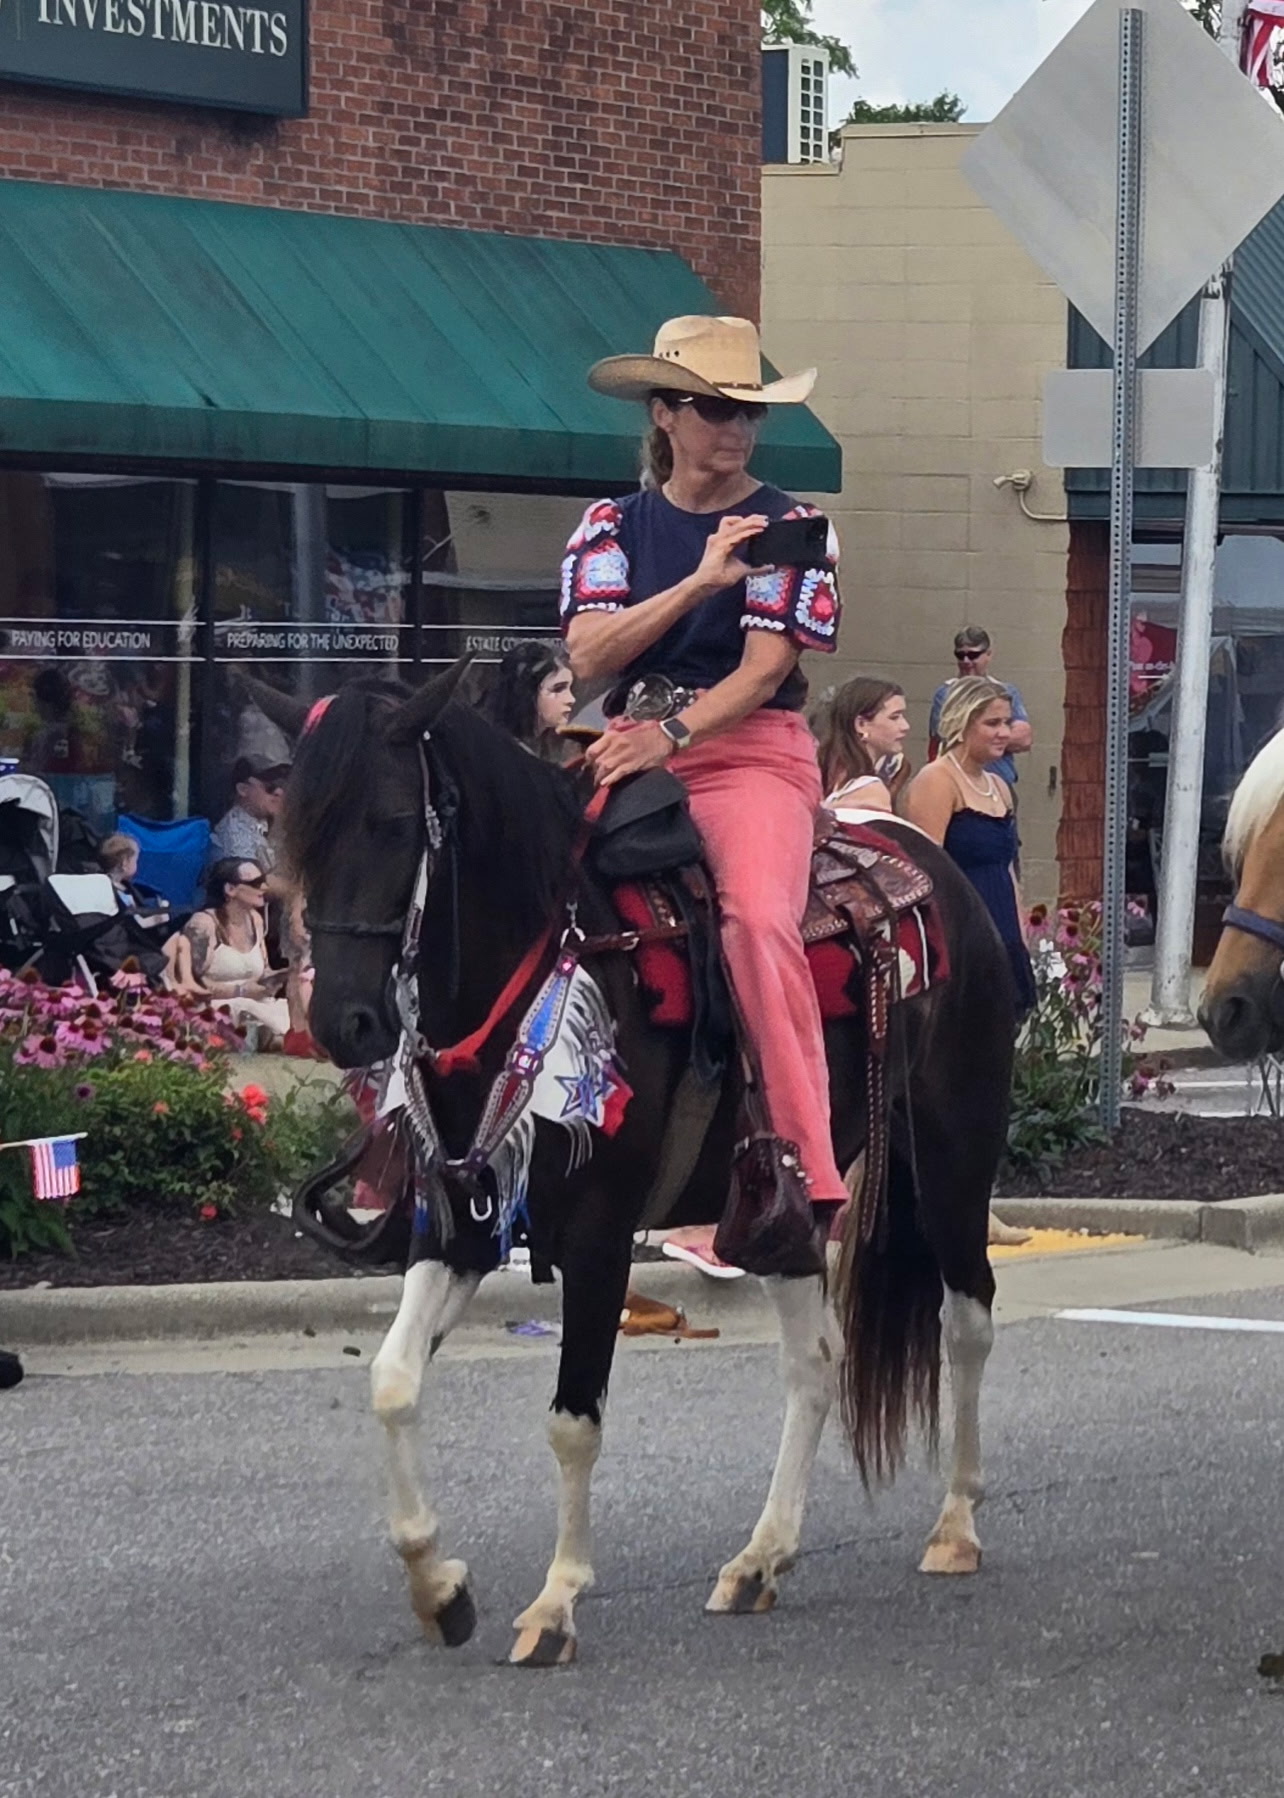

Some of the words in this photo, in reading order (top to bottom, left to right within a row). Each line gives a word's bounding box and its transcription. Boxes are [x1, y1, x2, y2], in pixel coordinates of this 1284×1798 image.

[38, 0, 288, 57] INVESTMENTS
[11, 630, 56, 648] PAYING
[57, 631, 81, 648] FOR
[83, 632, 151, 648] EDUCATION
[227, 632, 286, 649] PREPARING
[288, 633, 309, 649] FOR
[311, 634, 331, 650] THE
[333, 635, 399, 650] UNEXPECTED
[466, 636, 500, 652] ESTATE
